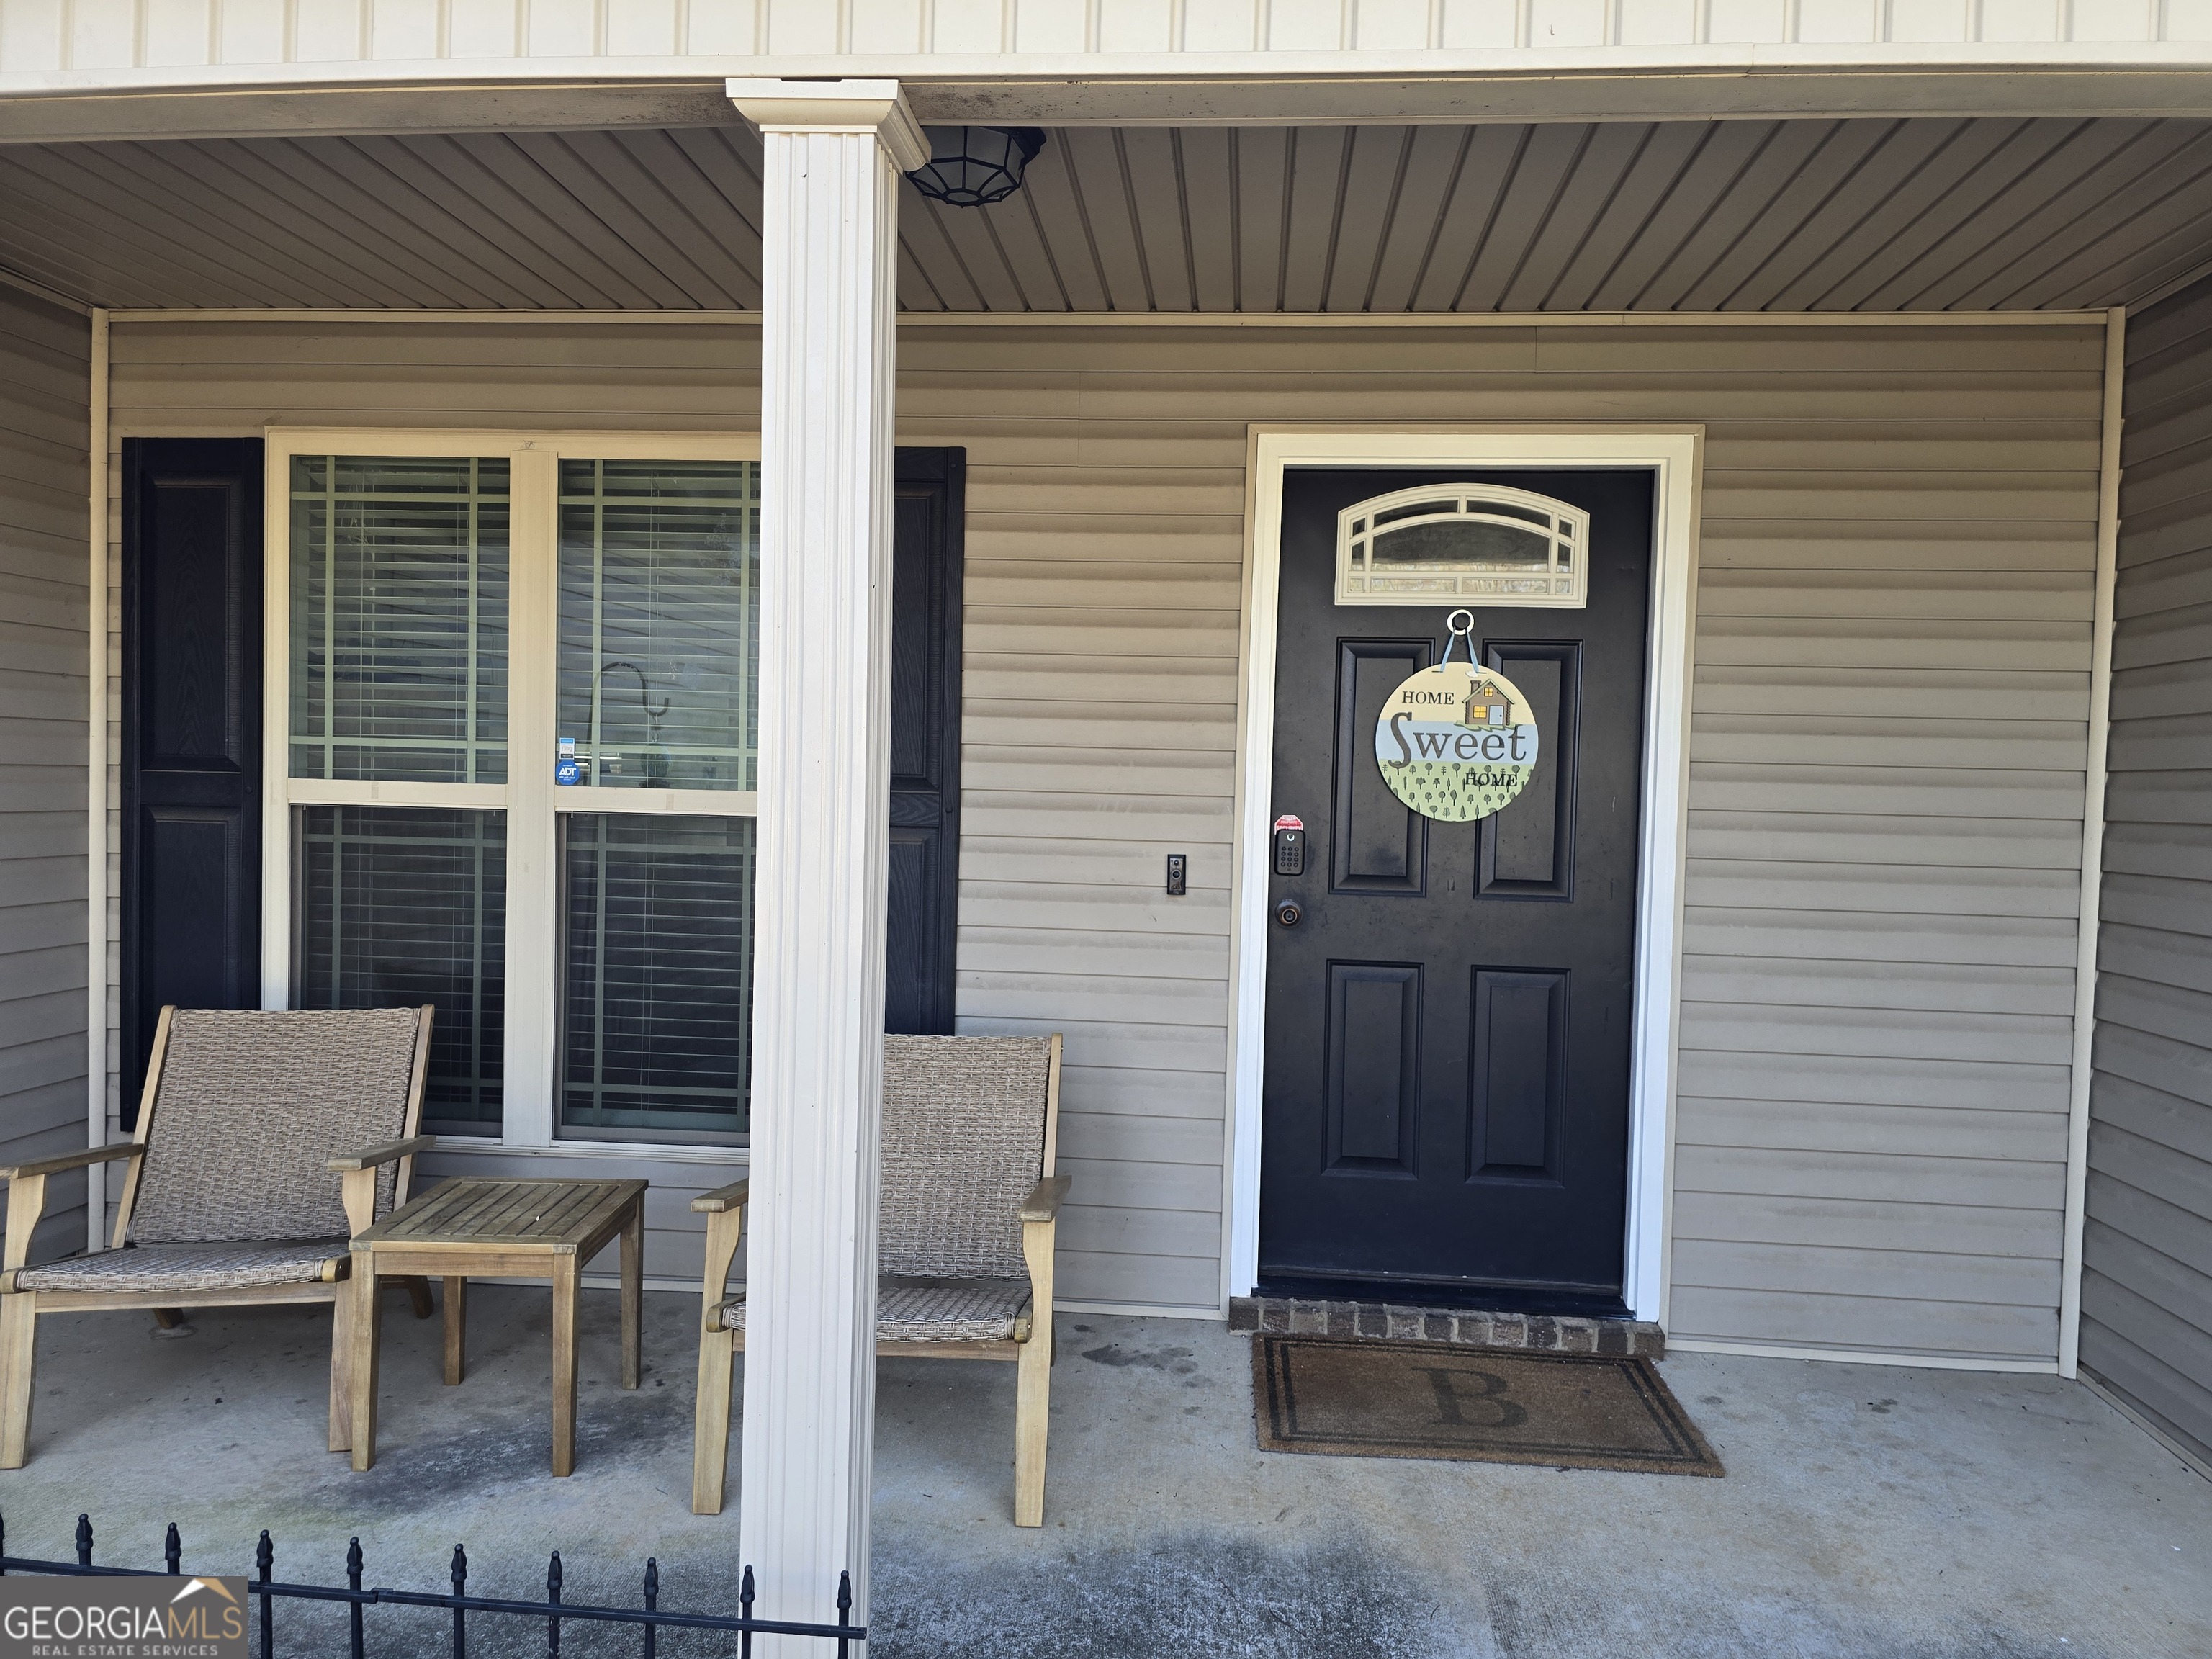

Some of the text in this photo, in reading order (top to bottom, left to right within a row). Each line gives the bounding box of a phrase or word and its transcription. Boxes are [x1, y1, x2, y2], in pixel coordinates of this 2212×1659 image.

[1401, 691, 1455, 705] HOME
[1388, 711, 1527, 768] Sweet
[559, 767, 576, 776] ADT
[1465, 772, 1518, 786] HOME
[1413, 1367, 1528, 1427] B
